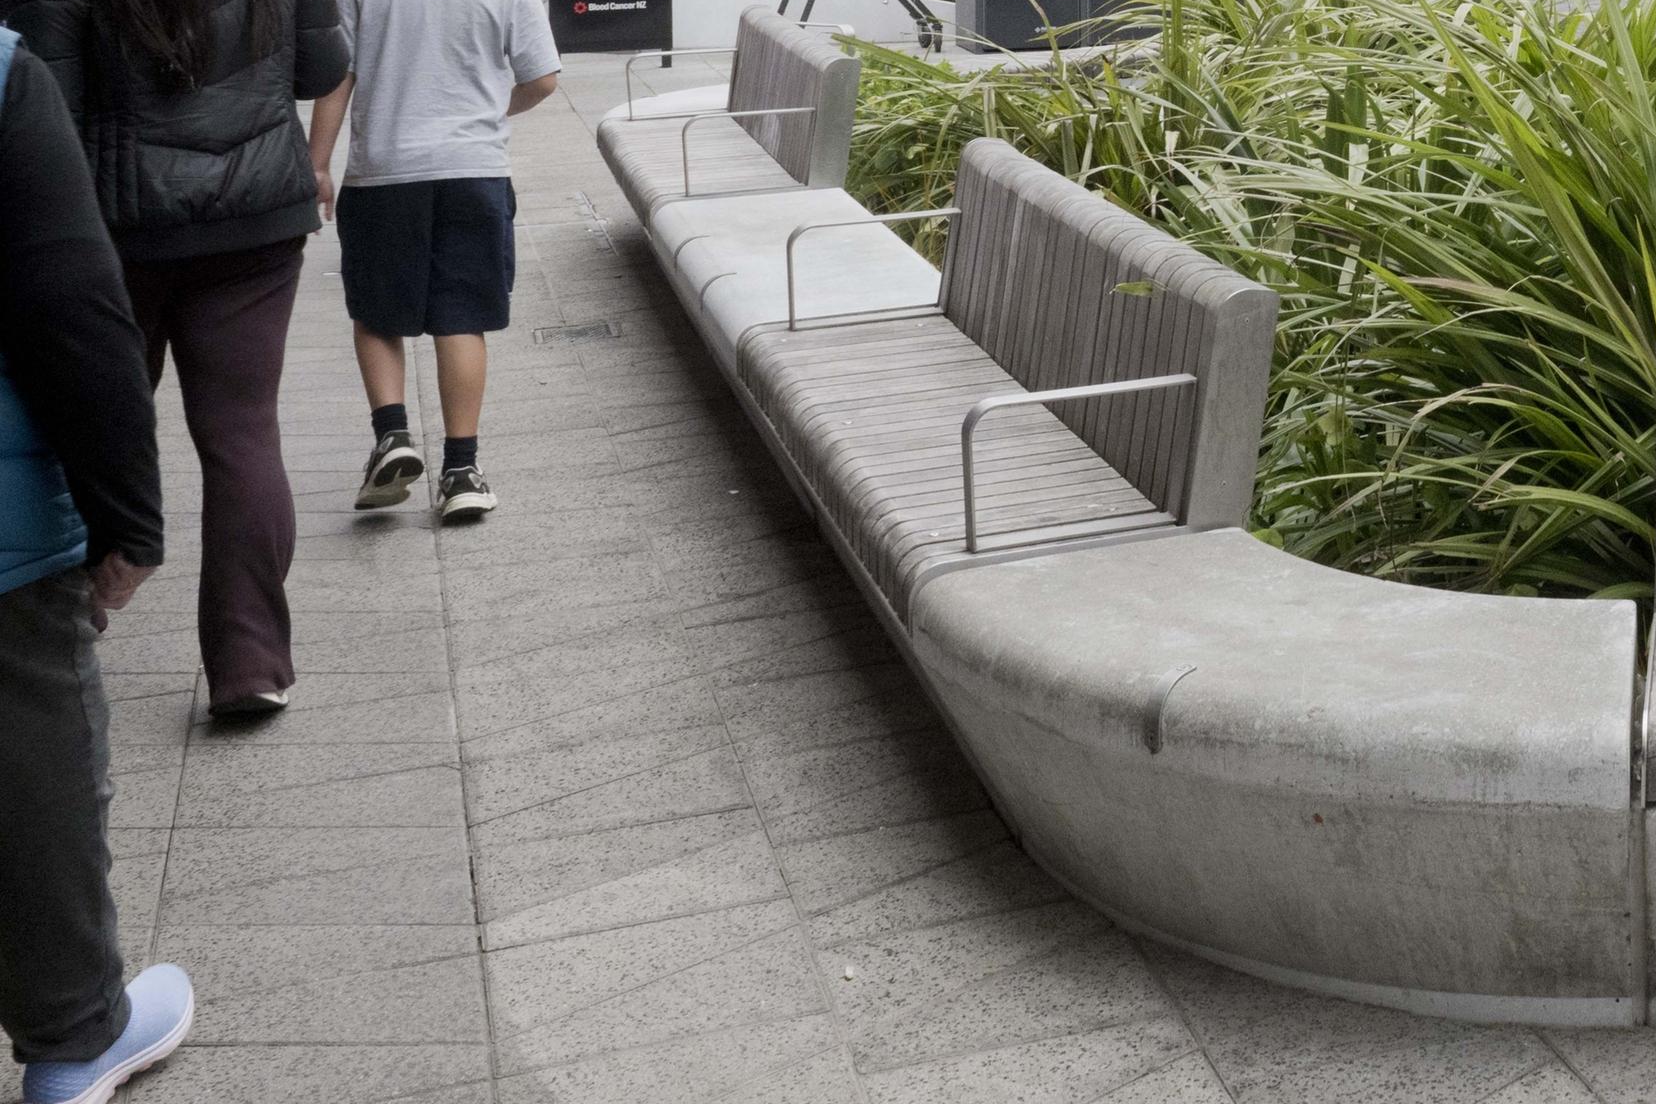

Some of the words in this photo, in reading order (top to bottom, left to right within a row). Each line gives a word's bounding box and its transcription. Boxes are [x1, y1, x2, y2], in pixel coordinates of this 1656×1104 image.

[588, 2, 610, 11] Blood
[609, 2, 636, 10] Cancer
[635, 0, 647, 9] NZ
